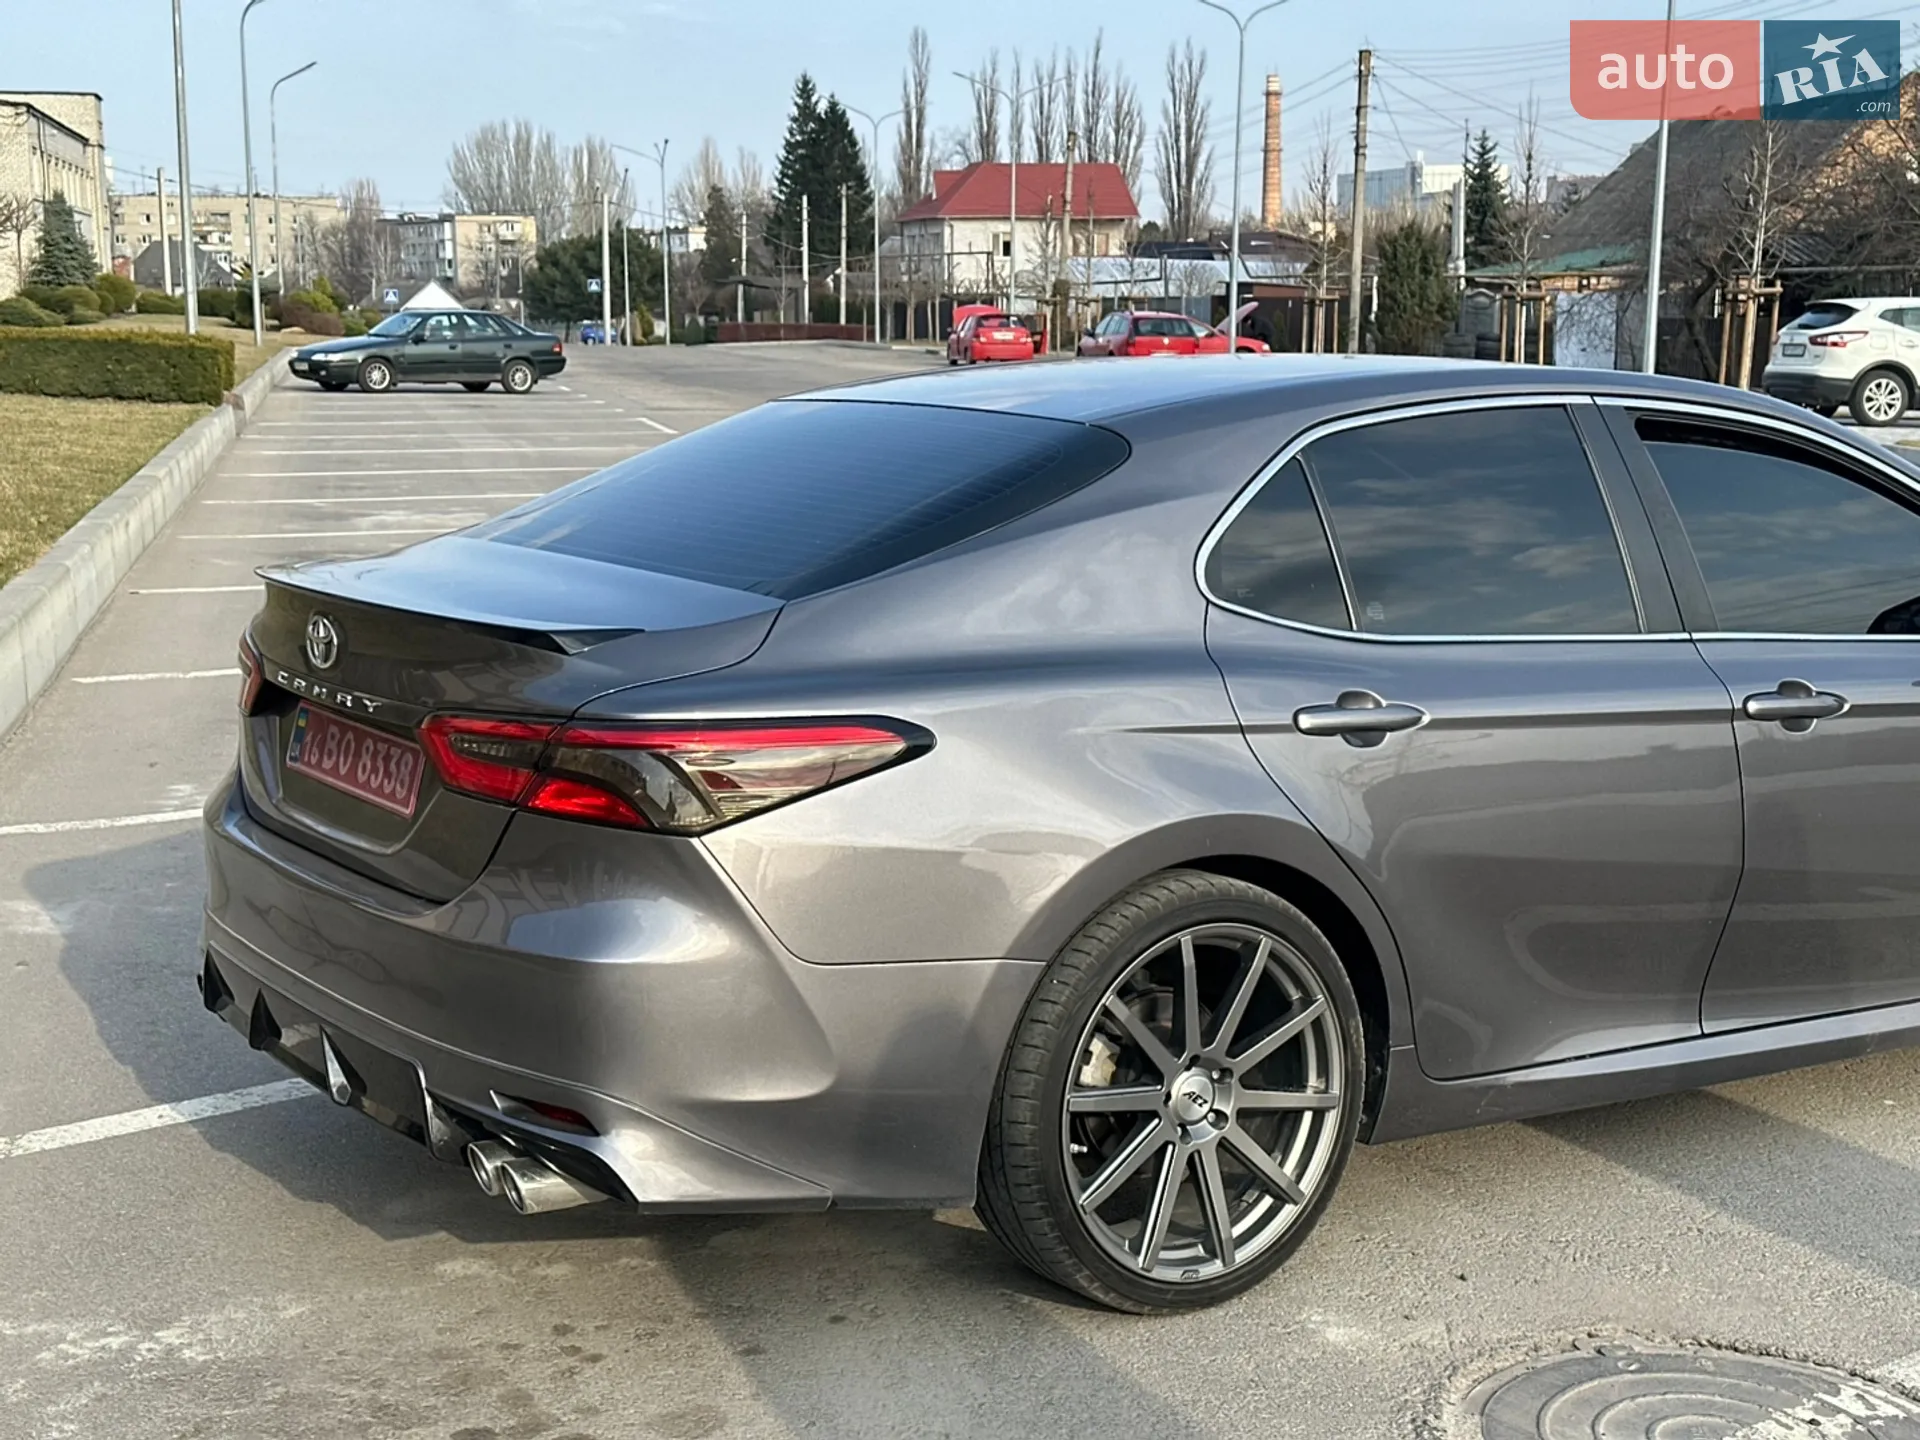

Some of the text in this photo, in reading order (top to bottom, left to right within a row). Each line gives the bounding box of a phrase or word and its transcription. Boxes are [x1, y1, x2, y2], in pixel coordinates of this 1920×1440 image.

[277, 670, 382, 713] CAMRY
[357, 737, 413, 800] 8338
[1182, 1090, 1209, 1108] AEZ
